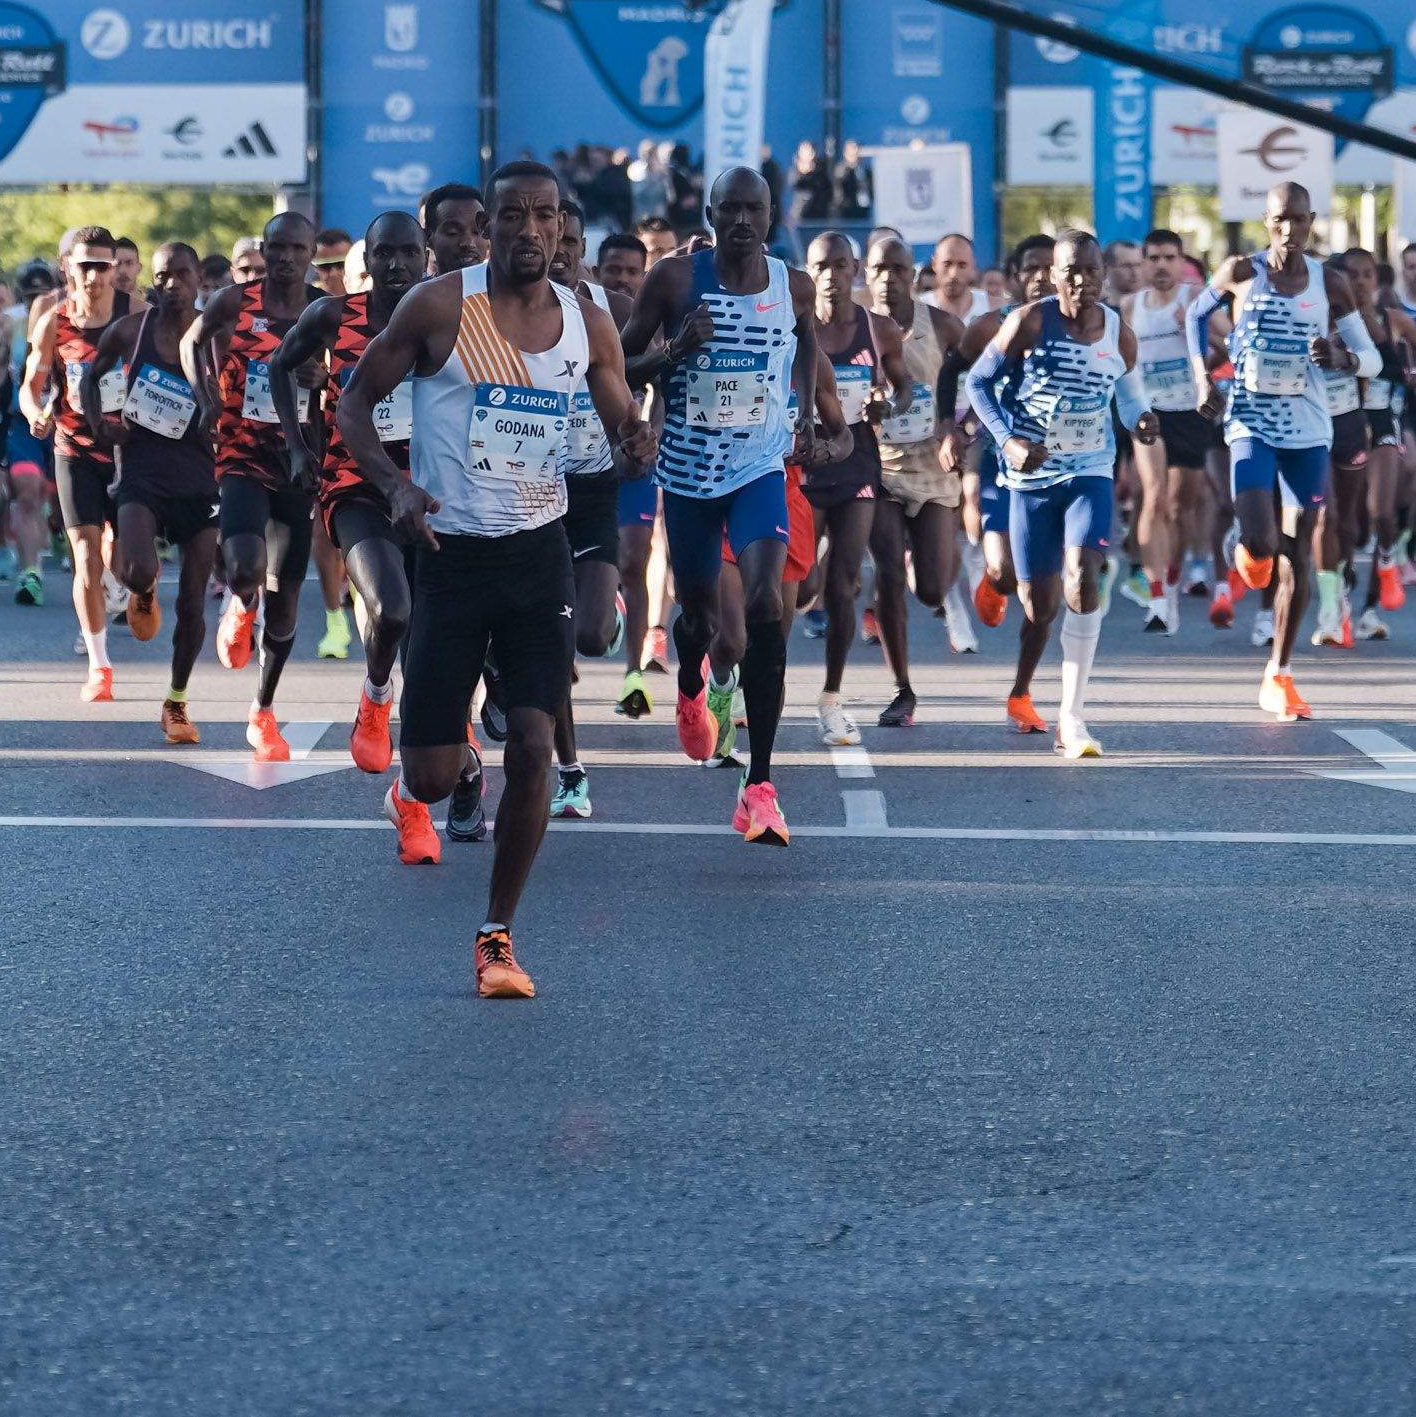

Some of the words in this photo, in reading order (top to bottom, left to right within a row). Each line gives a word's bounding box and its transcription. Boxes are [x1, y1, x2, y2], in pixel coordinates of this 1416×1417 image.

[142, 19, 273, 50] ZURICH
[1111, 68, 1146, 222] ZURICH
[715, 358, 755, 367] ZURICH
[715, 380, 738, 392] PACE
[511, 393, 558, 410] ZURICH
[720, 395, 731, 406] 21
[377, 408, 390, 419] 22
[570, 418, 587, 428] EDE
[495, 420, 545, 439] GODANA
[513, 441, 522, 454] 7
